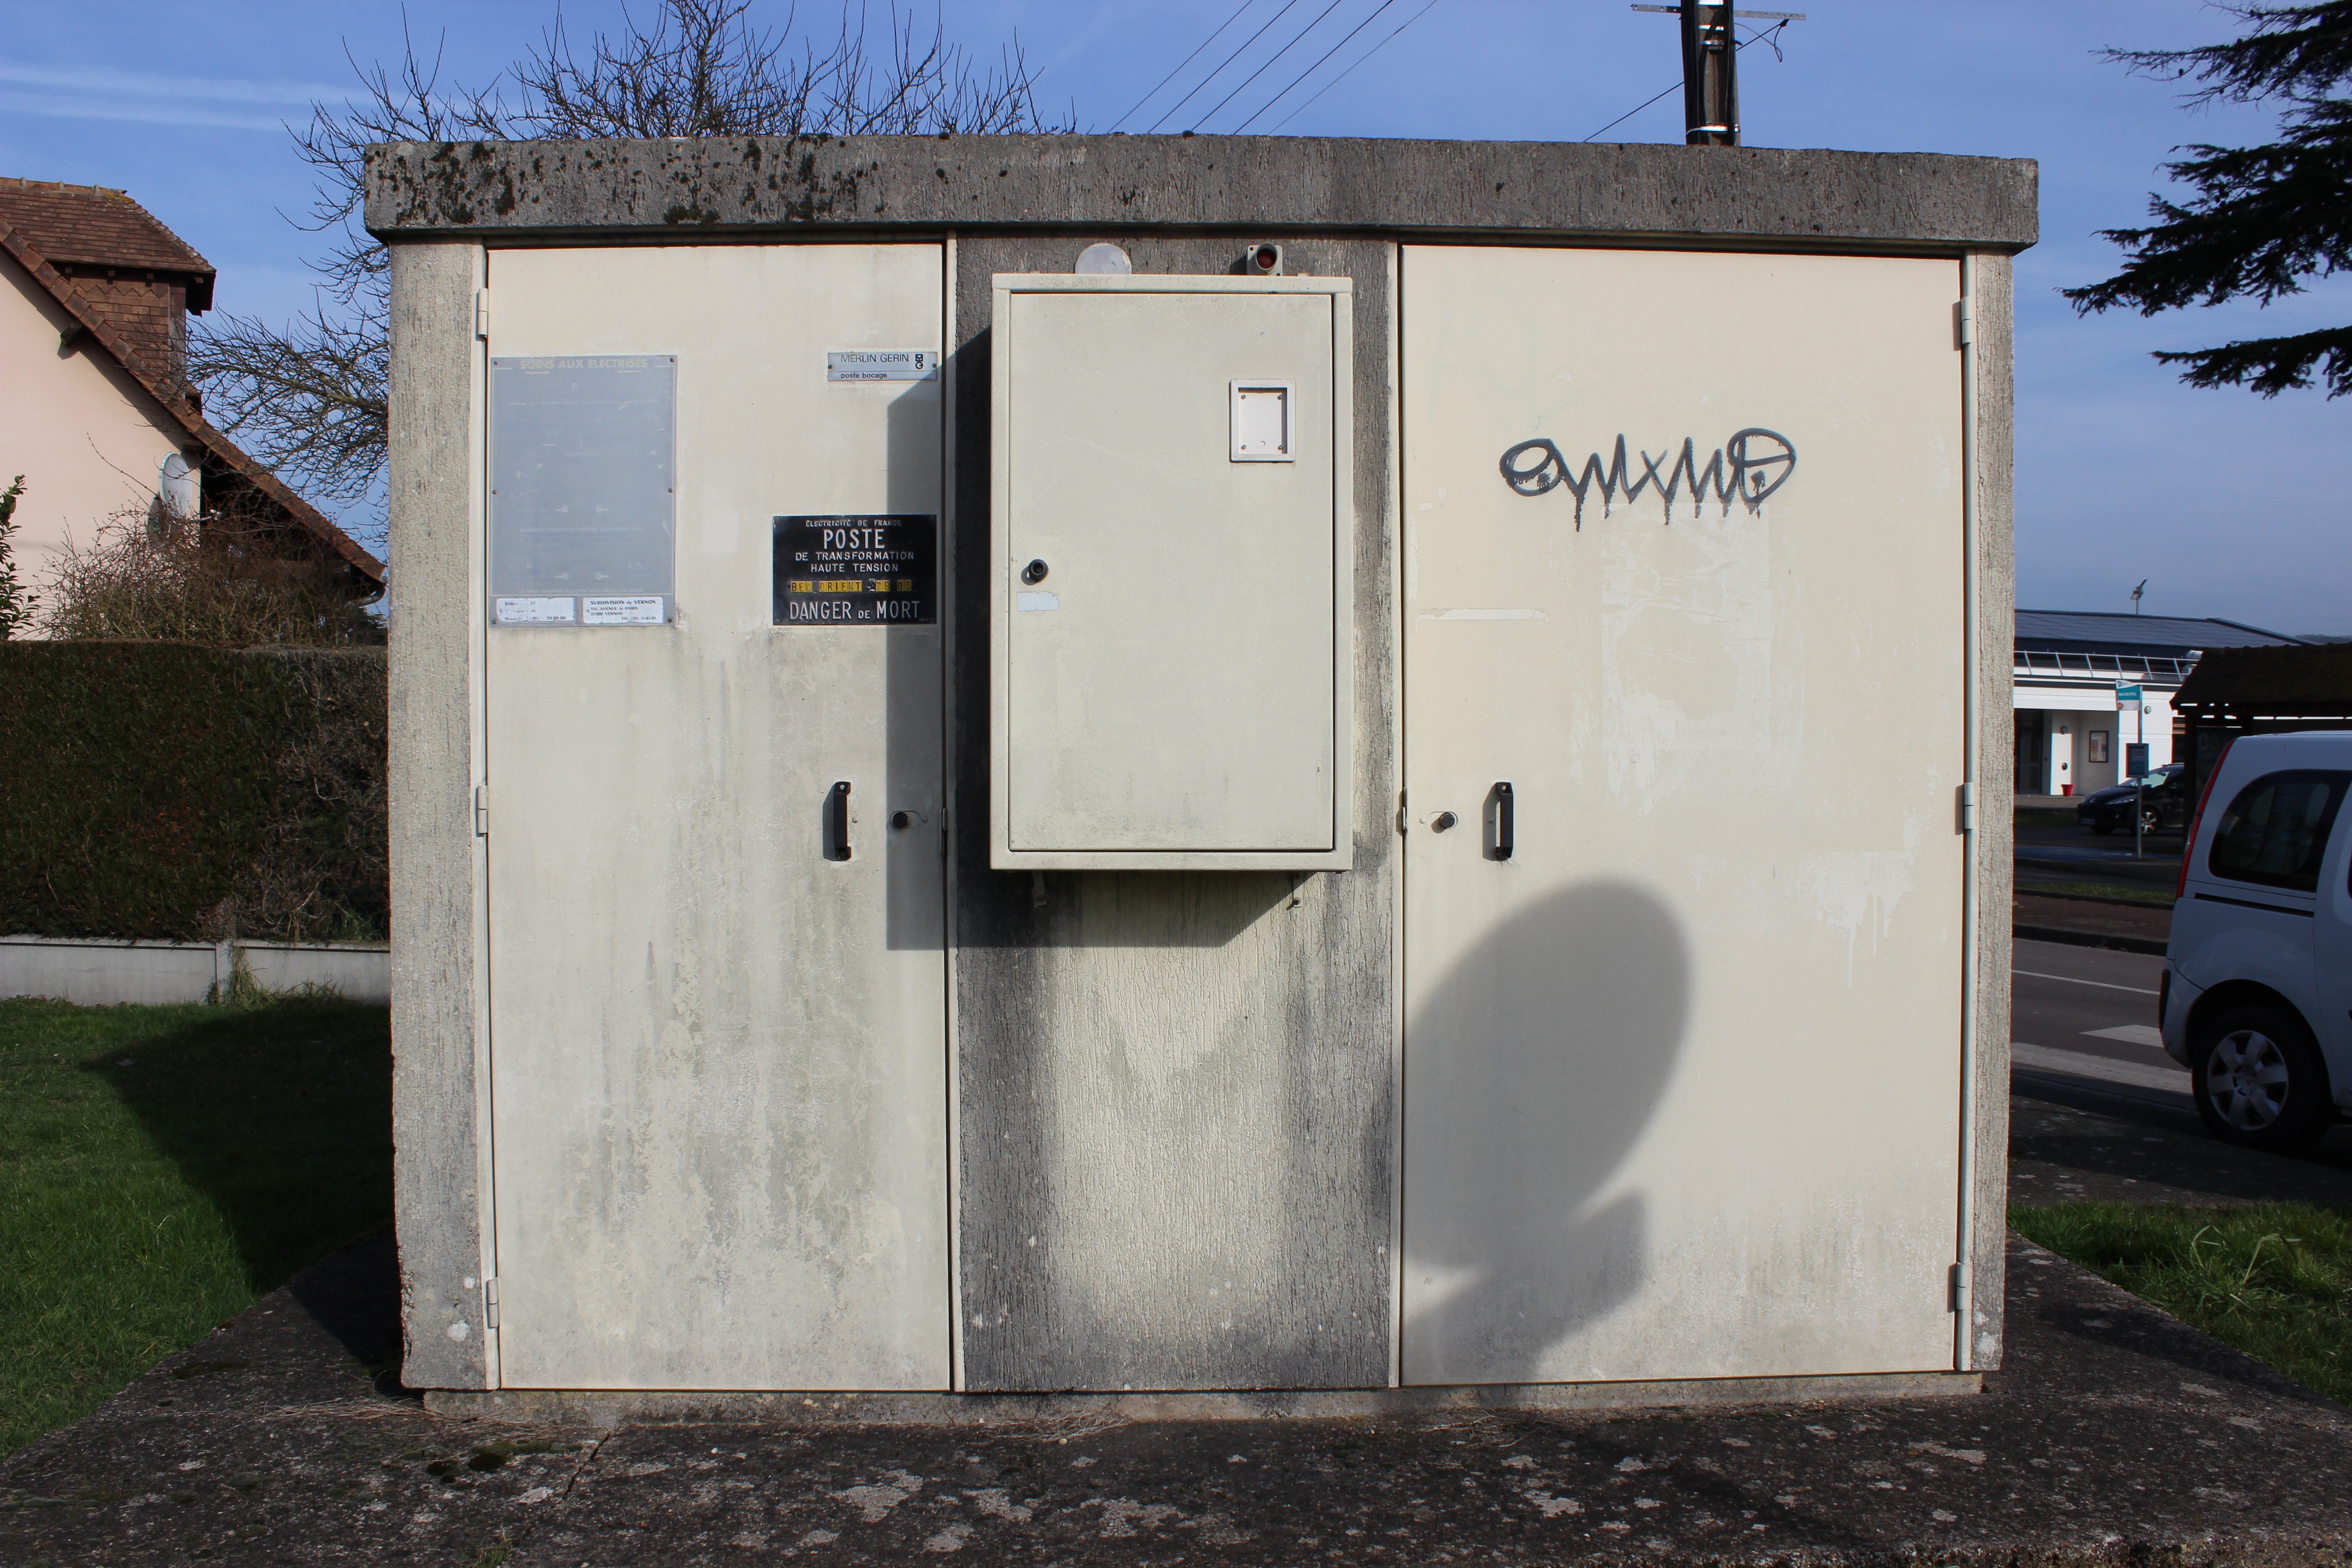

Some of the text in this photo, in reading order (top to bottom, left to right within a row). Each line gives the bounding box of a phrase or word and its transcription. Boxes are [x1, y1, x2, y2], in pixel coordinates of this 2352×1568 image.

[841, 354, 909, 363] MERLIN GERIN
[520, 360, 554, 369] SOINS
[559, 359, 583, 368] AUX
[823, 529, 885, 549] POSTE
[795, 551, 914, 561] DE TRANSFORMATION
[811, 563, 898, 573] HAUTE TENSION
[790, 602, 852, 621] DANGER
[876, 601, 920, 619] MORT
